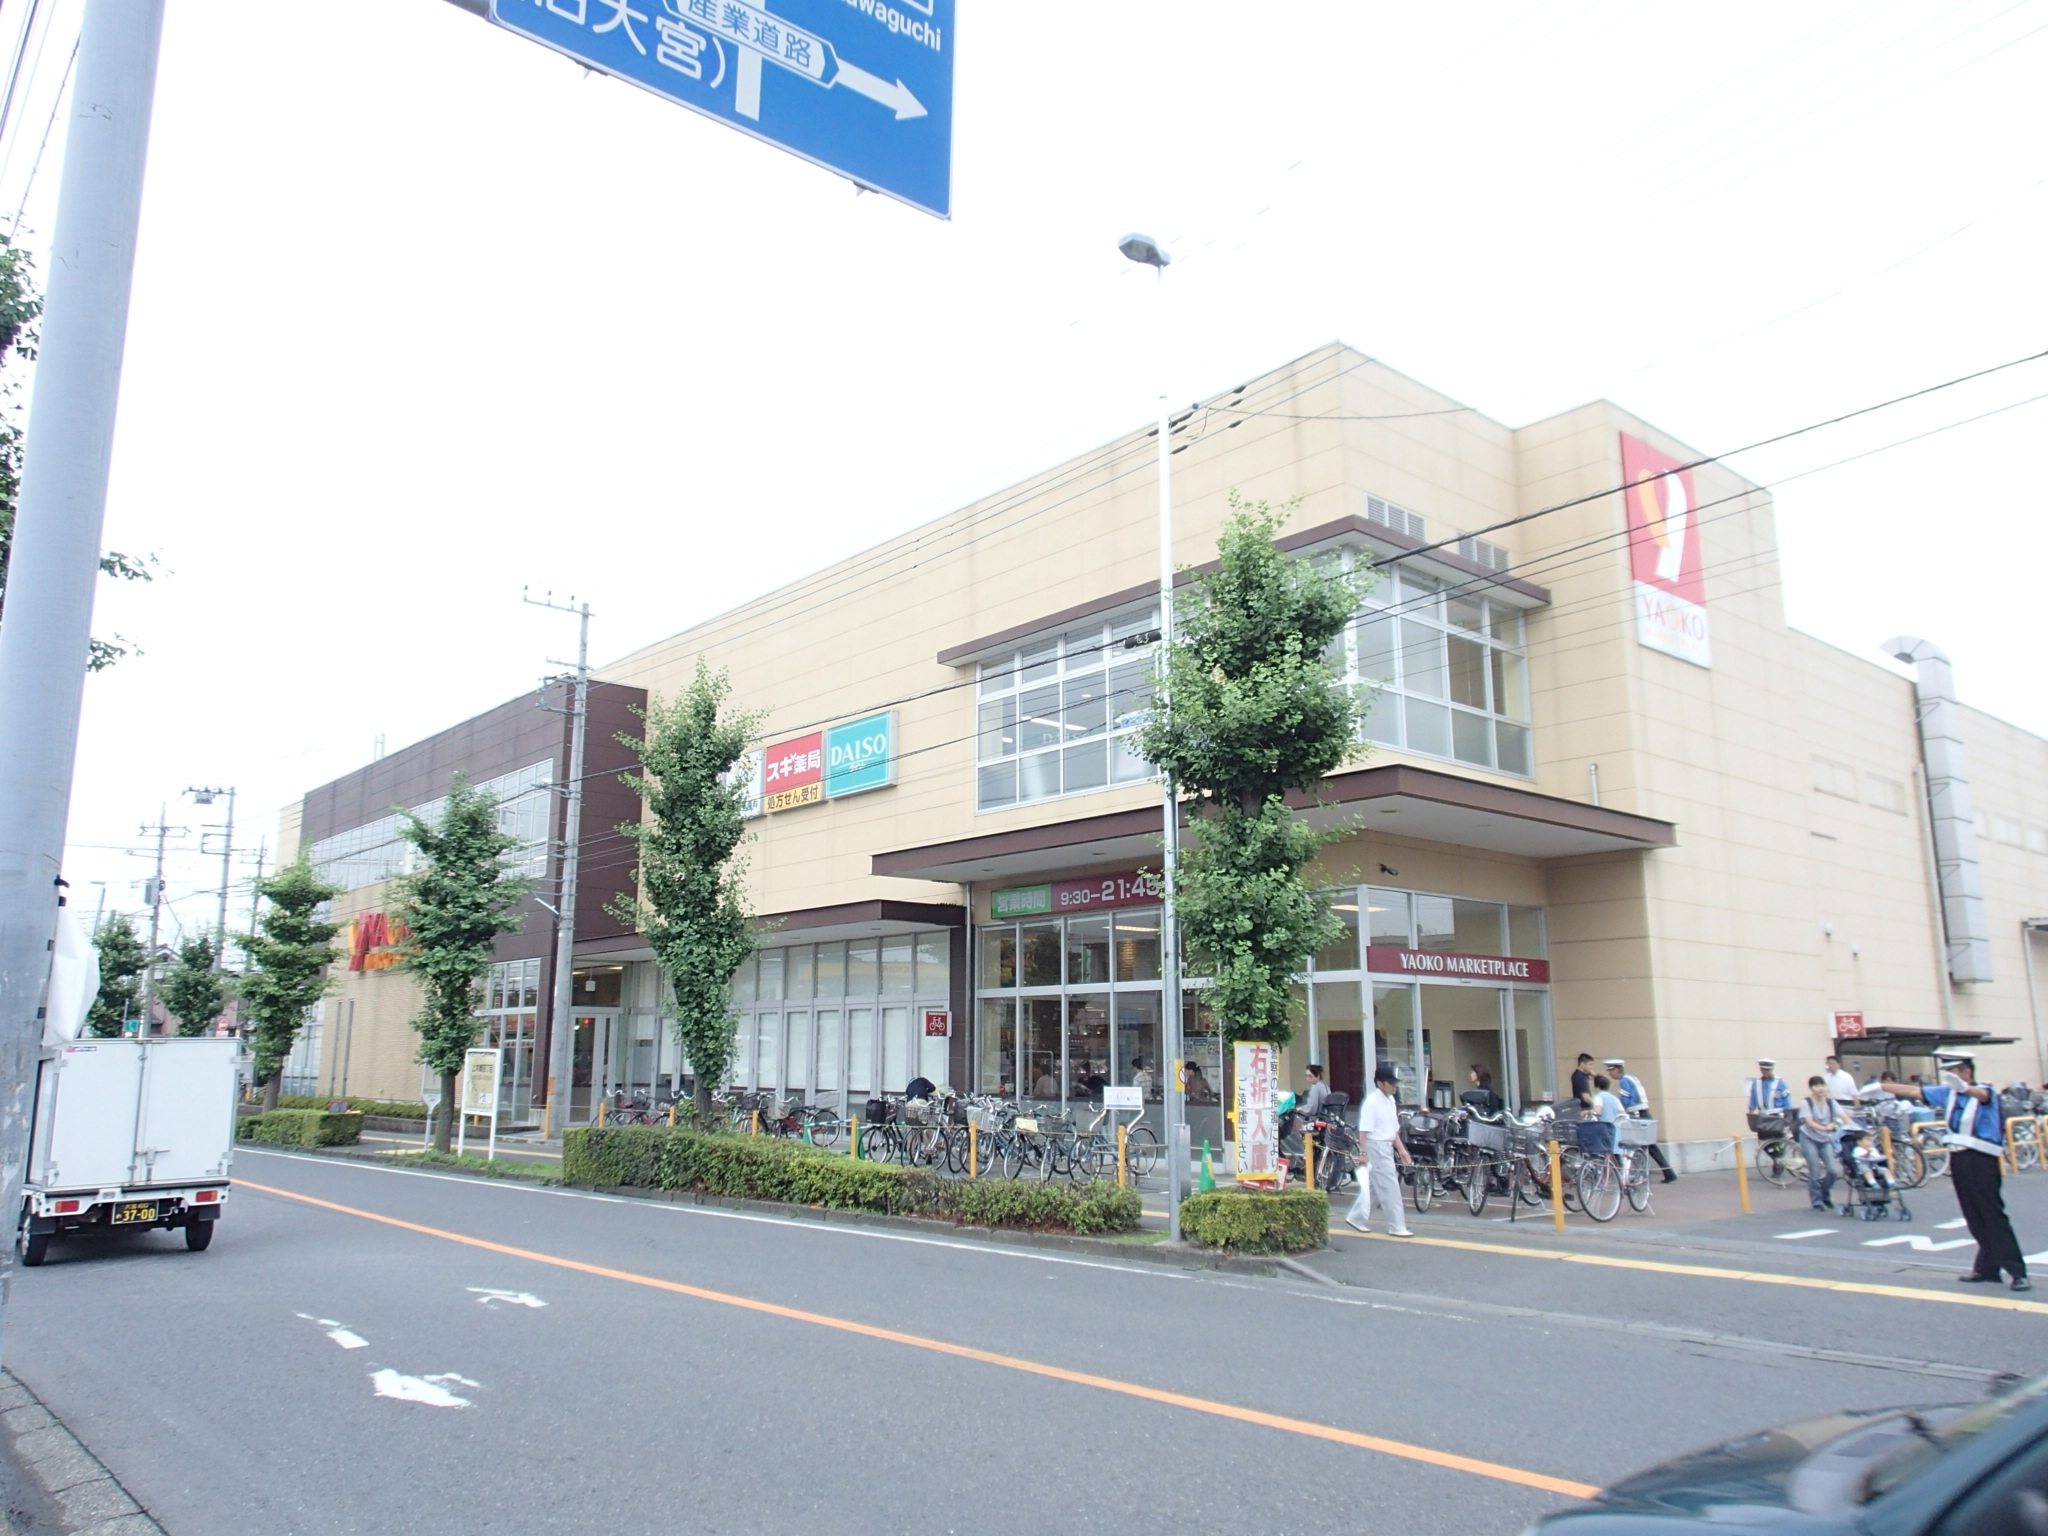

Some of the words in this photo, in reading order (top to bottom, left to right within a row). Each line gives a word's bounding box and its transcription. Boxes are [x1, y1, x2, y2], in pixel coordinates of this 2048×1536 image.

[1641, 593, 1705, 641] YAOKO
[831, 735, 886, 766] DAISO
[767, 748, 821, 782] スギ薬局
[767, 785, 819, 810] 処方せん受付
[997, 889, 1046, 913] 営業時間
[1400, 953, 1444, 971] YAOKO
[1447, 956, 1530, 978] MARKETPLACE
[1250, 1045, 1269, 1173] 右折入庫
[122, 1208, 156, 1221] 37-00
